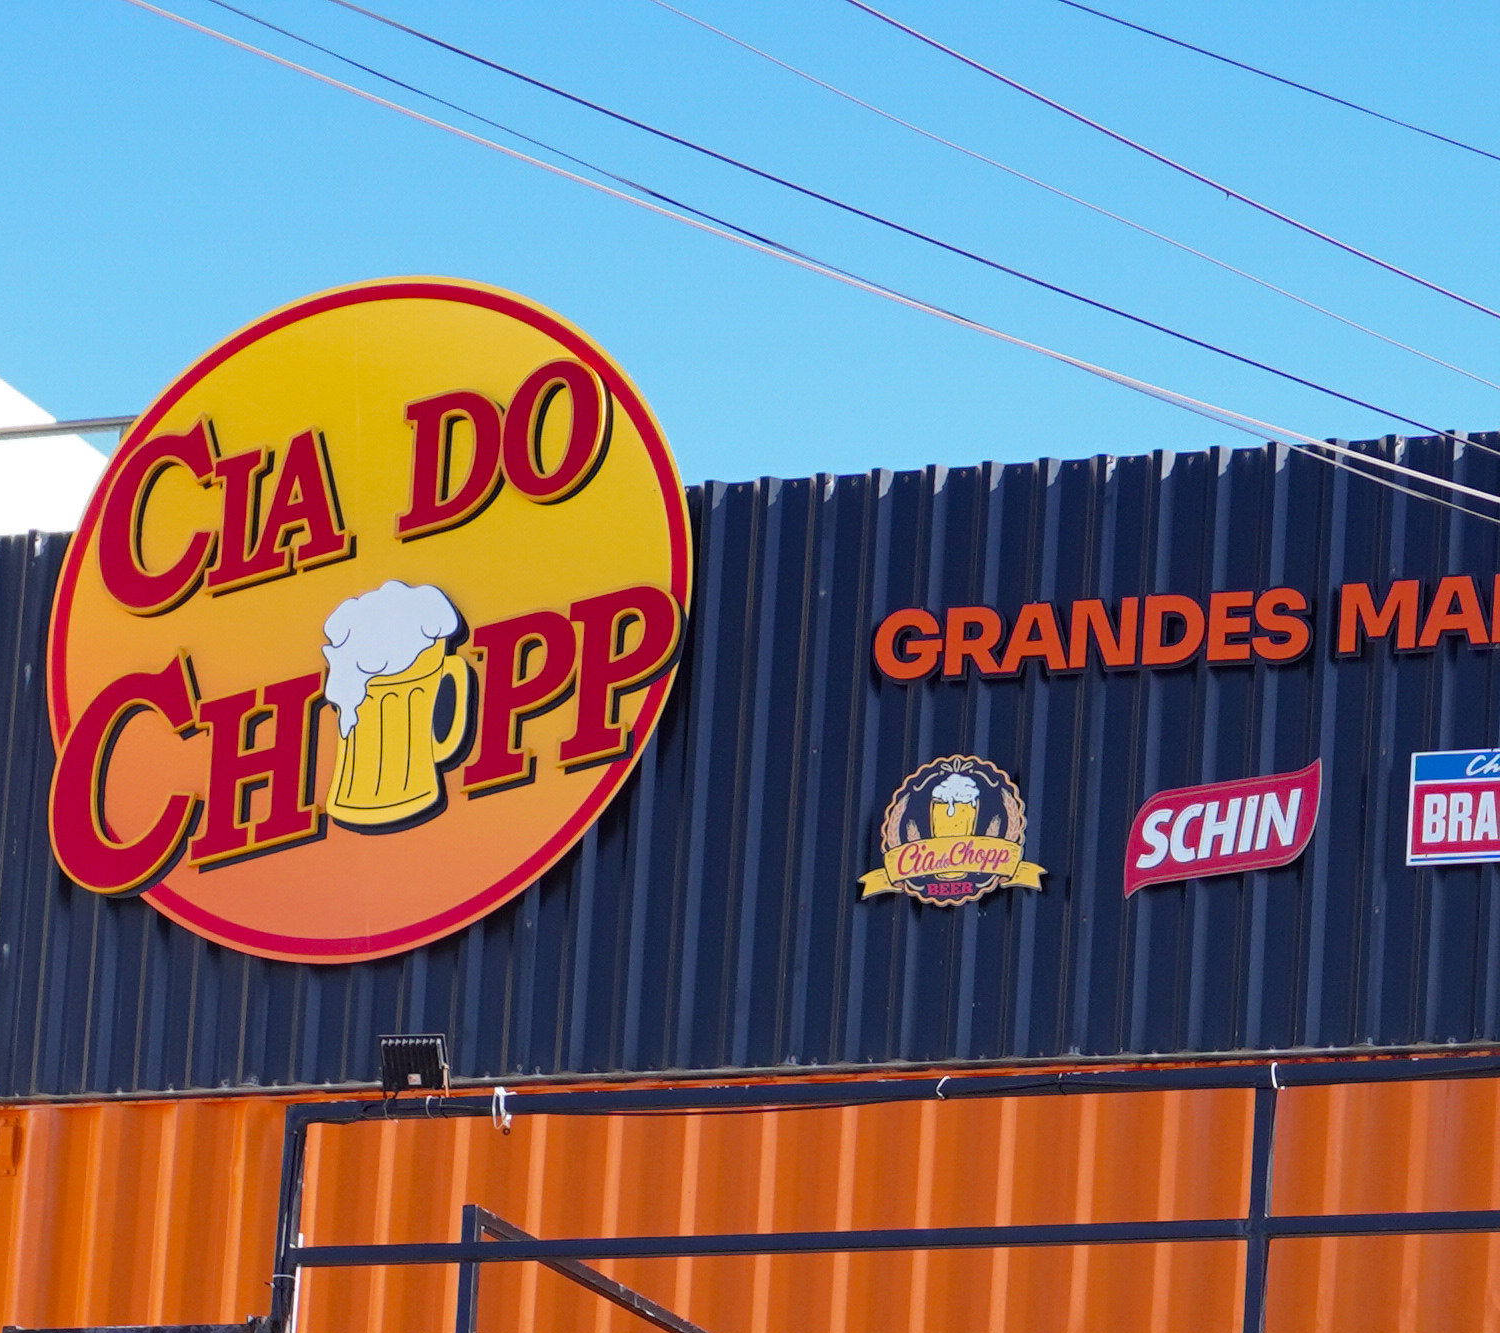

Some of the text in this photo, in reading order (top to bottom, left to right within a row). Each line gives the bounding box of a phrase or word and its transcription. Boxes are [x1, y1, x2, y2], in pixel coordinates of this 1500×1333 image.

[97, 359, 609, 614] CIA DO
[873, 586, 1311, 682] GRANDES
[898, 843, 935, 875] Cia
[950, 840, 1011, 870] Chopp
[1136, 787, 1302, 869] SCHIN
[927, 882, 973, 895] BEER
